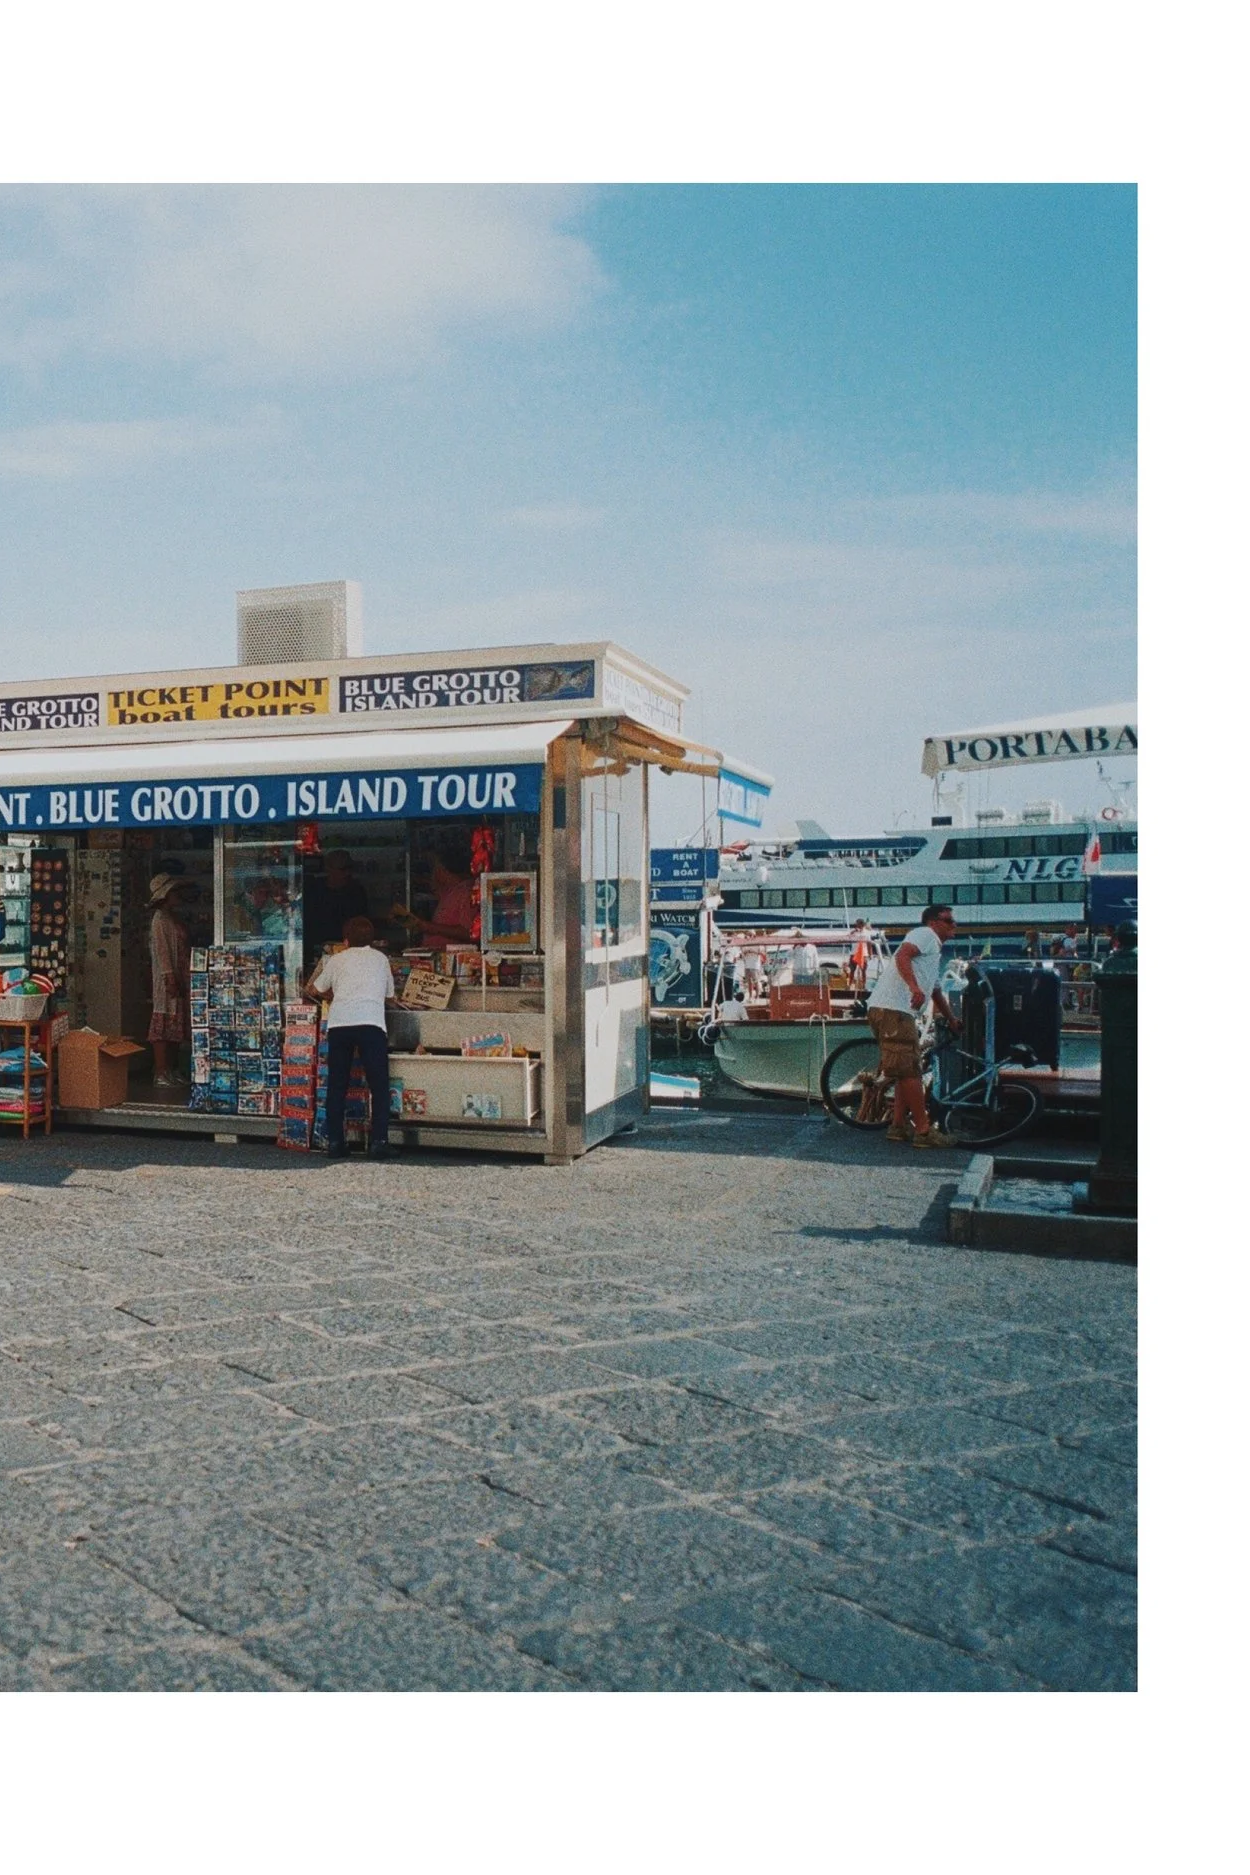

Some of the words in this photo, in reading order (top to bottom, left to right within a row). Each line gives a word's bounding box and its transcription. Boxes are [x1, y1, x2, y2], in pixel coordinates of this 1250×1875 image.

[108, 685, 214, 708] TICKET
[224, 677, 328, 701] POINT
[344, 676, 405, 696] BLUE
[412, 669, 521, 692] GROTTO
[11, 696, 98, 716] GROTTO
[344, 692, 438, 713] ISLAND
[444, 686, 521, 706] TOUR
[36, 713, 99, 730] TOUR
[118, 705, 196, 725] boat
[218, 702, 317, 719] tours
[49, 788, 120, 825] BLUE
[131, 783, 260, 822] GROTTO
[286, 776, 407, 818] ISLAND
[417, 771, 517, 811] TOUR
[672, 852, 699, 861] RENT
[682, 861, 690, 869] A
[672, 868, 699, 877] BOAT
[1002, 857, 1080, 881] NLG
